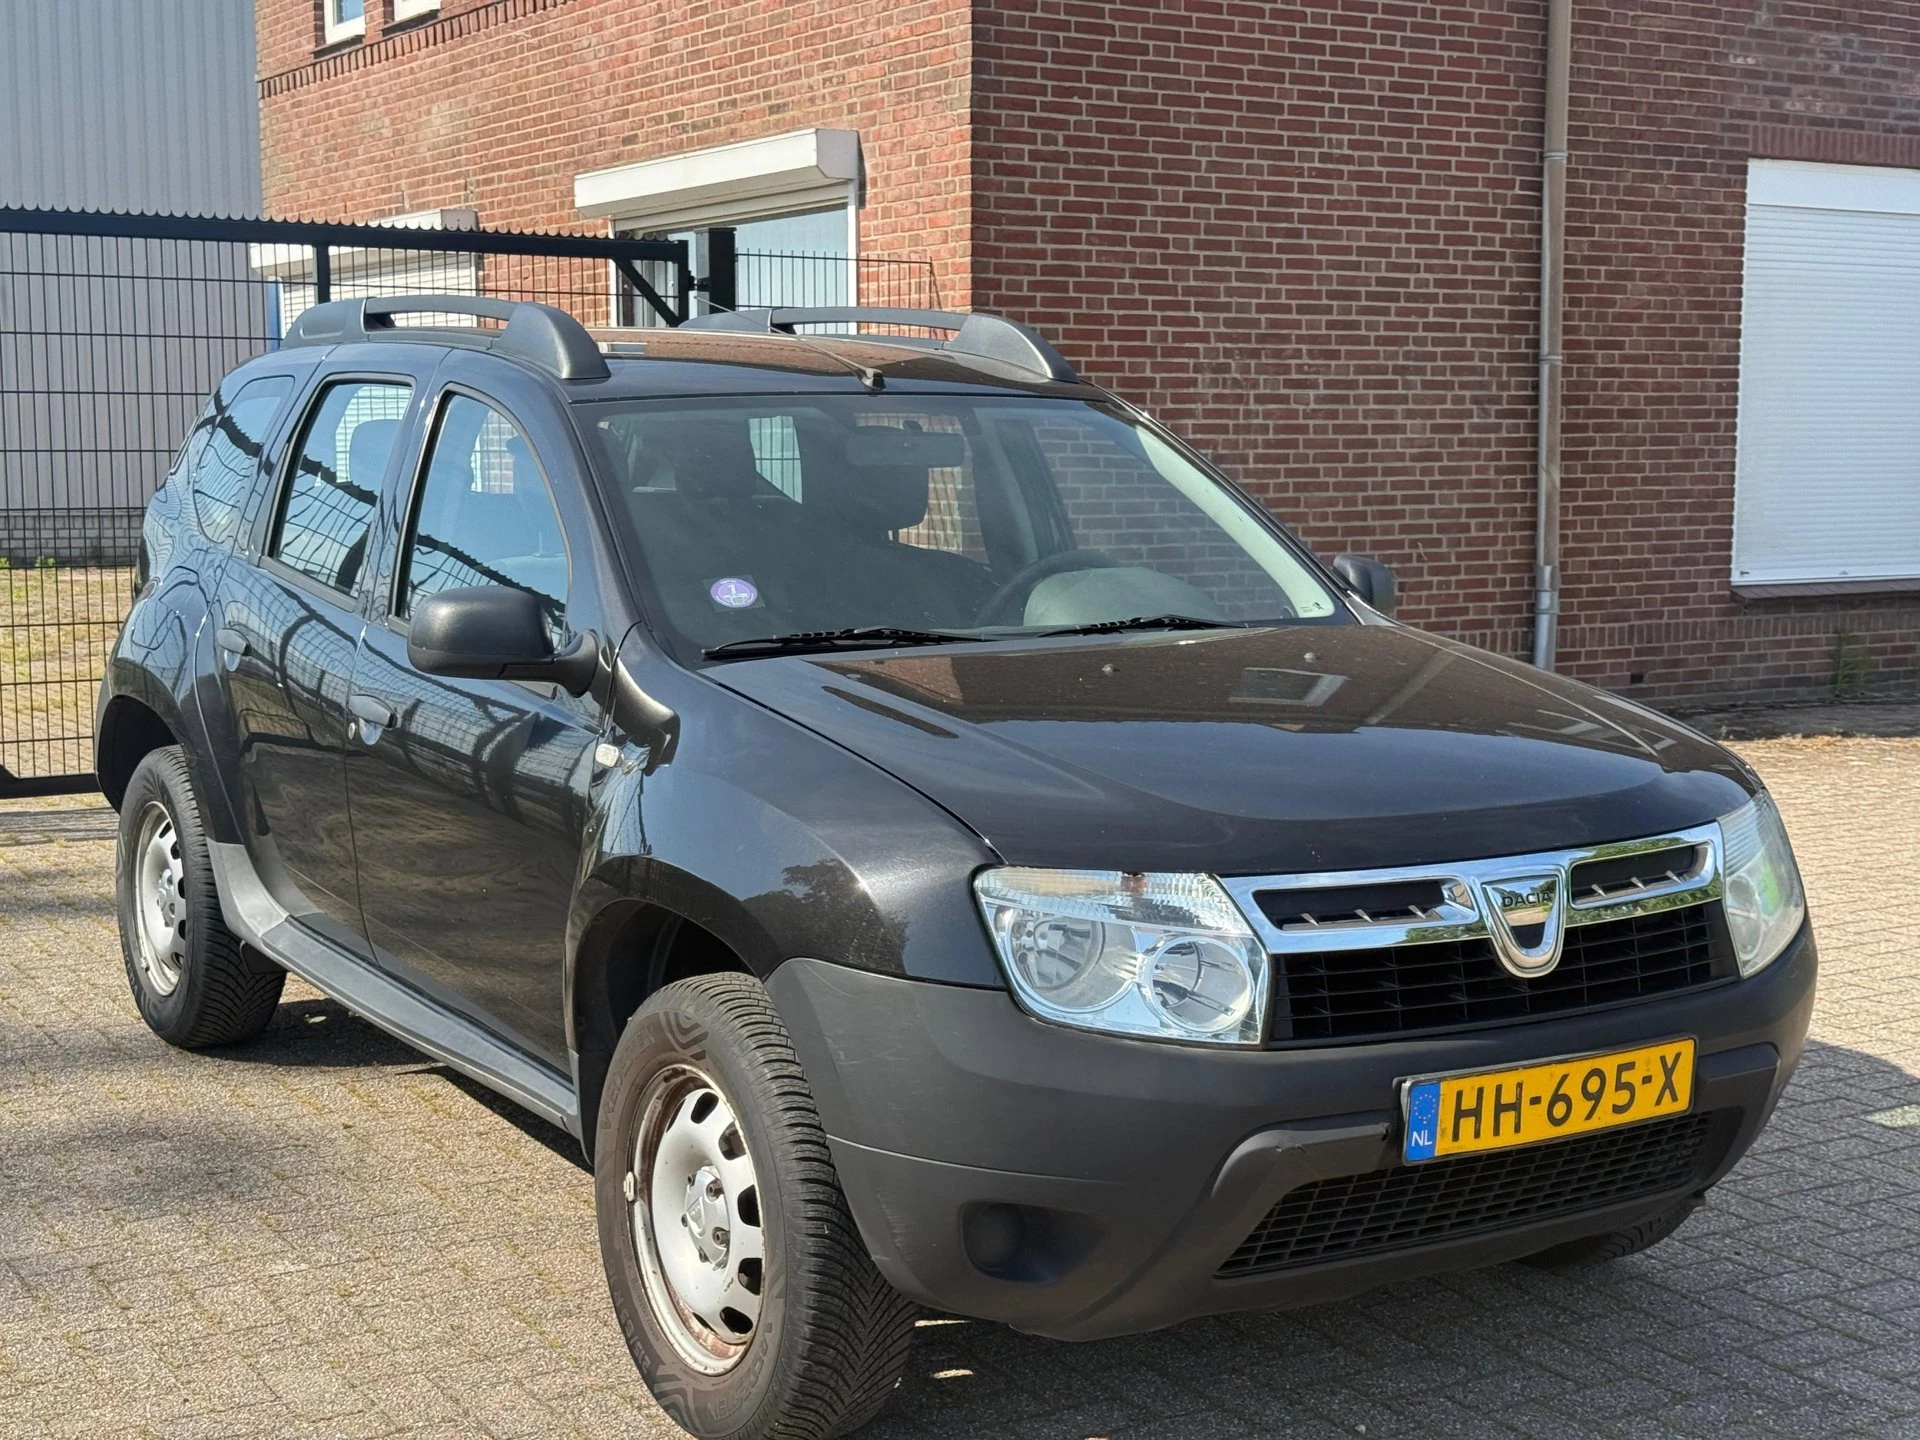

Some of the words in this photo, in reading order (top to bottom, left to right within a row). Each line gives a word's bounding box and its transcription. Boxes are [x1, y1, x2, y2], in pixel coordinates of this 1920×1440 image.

[727, 584, 736, 594] 1
[1502, 891, 1551, 907] DACIA
[1451, 1051, 1682, 1142] HH-695-X
[1411, 1129, 1433, 1147] NL
